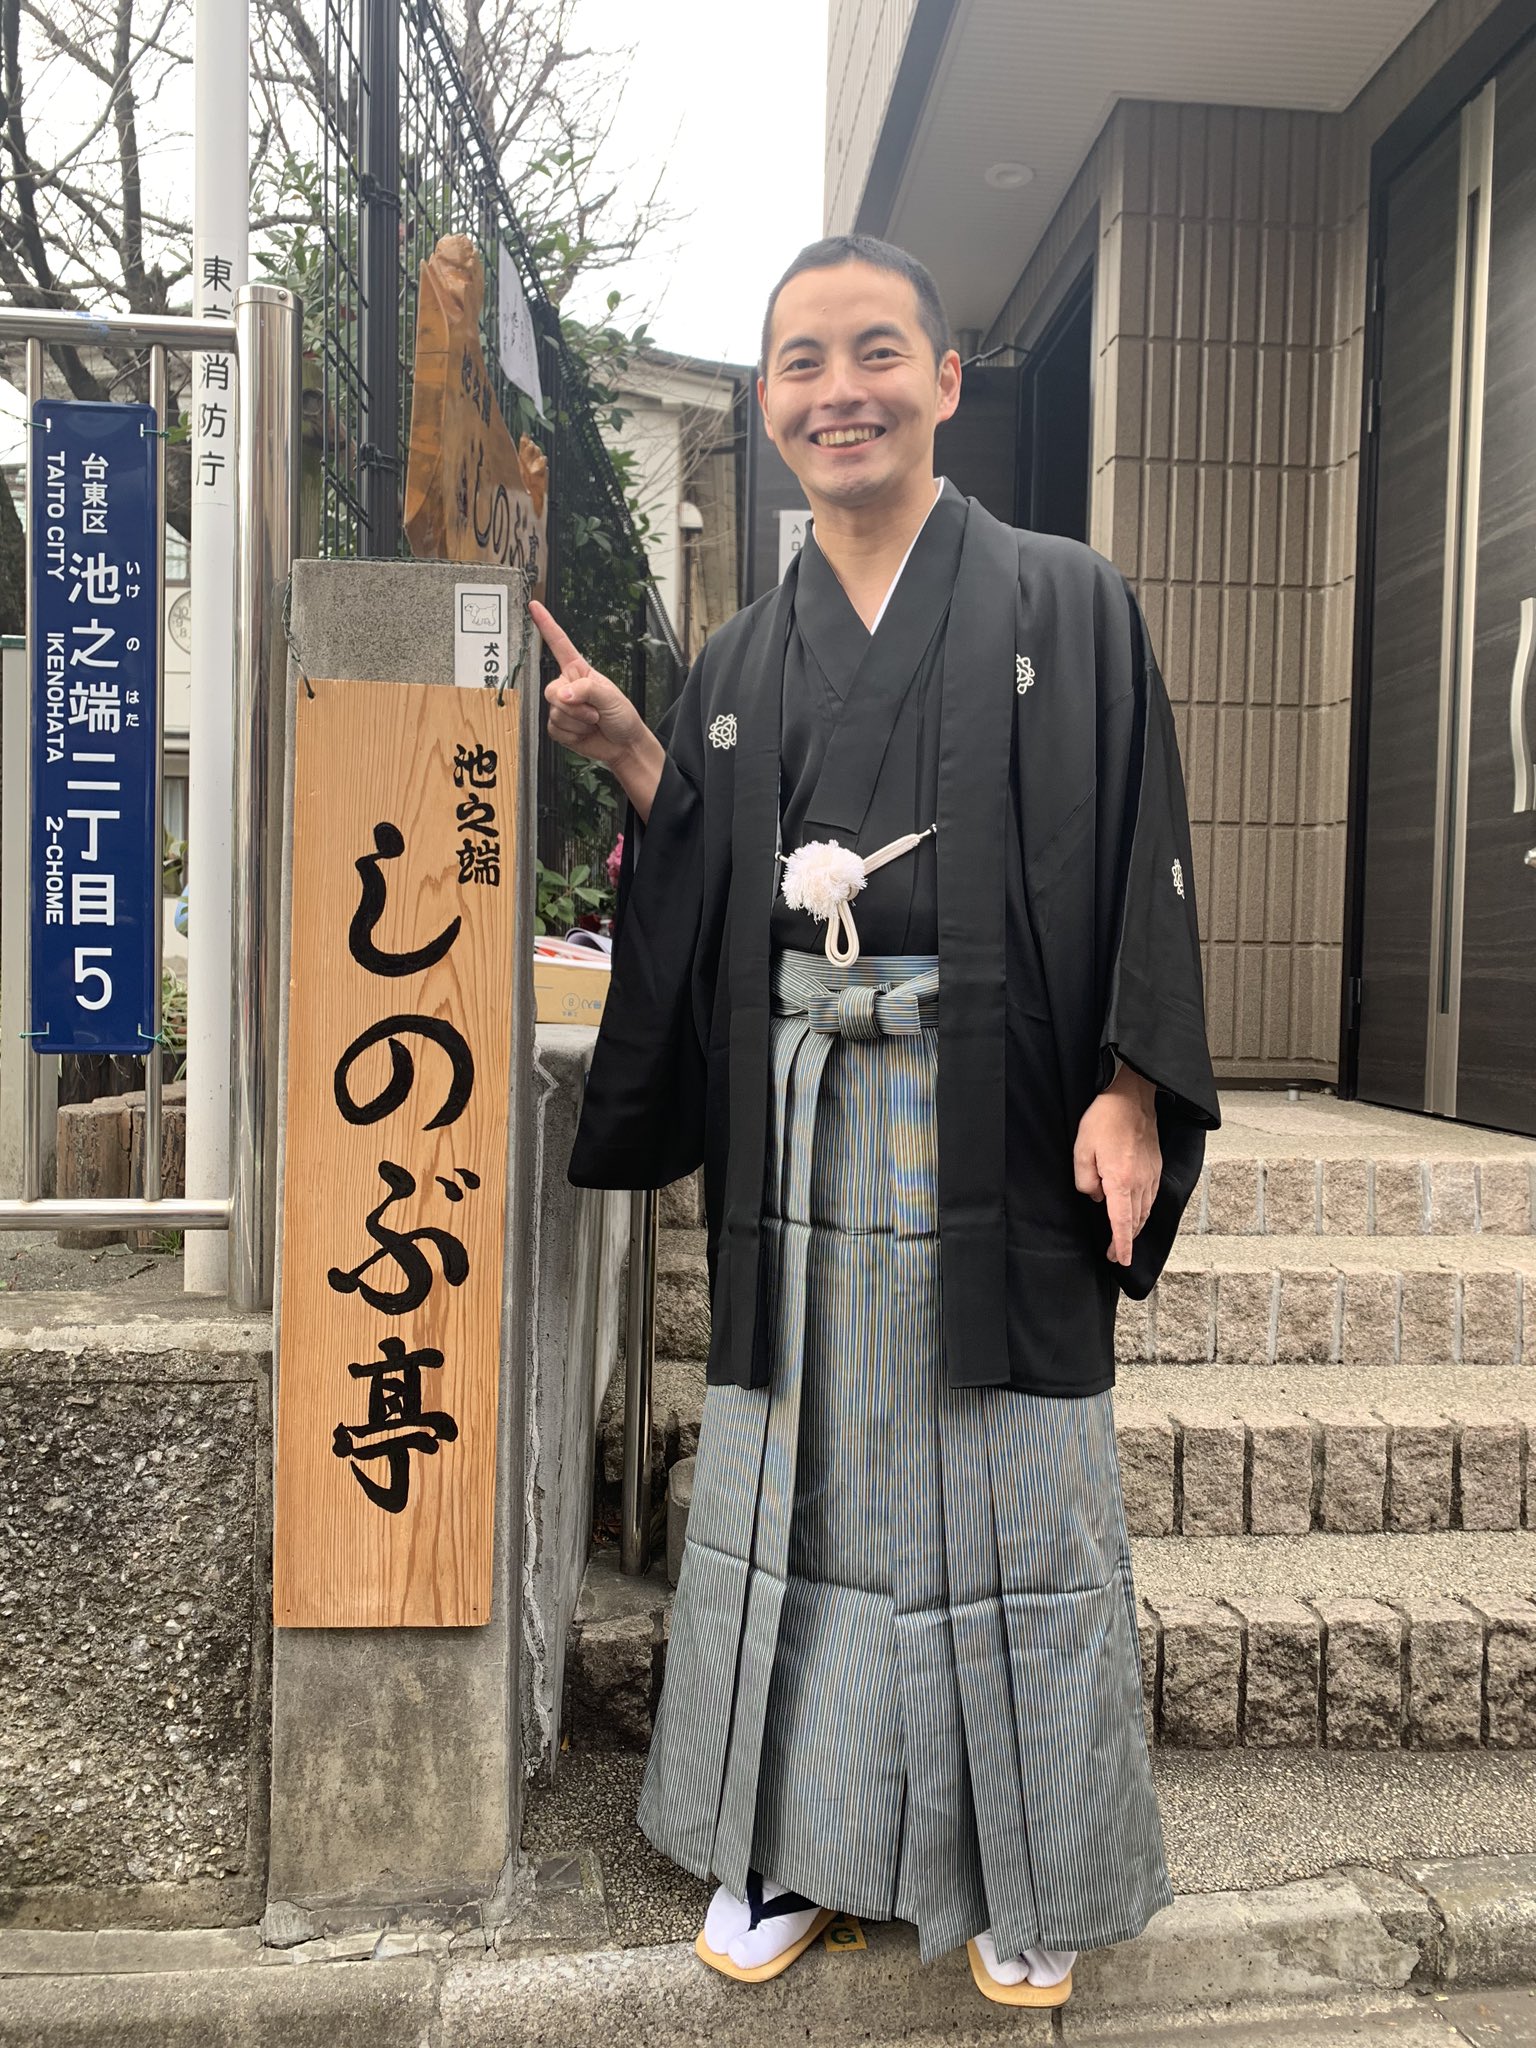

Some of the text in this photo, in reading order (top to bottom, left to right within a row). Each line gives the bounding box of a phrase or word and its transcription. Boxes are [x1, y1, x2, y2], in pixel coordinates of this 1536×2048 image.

[47, 451, 66, 582] TAITO CITY
[82, 453, 108, 534] 台東区
[125, 561, 141, 727] いけ の はた
[45, 632, 65, 925] IKENOHATA 2-CHOME
[453, 743, 501, 888] 池之端
[328, 822, 481, 1514] しのぶ亭
